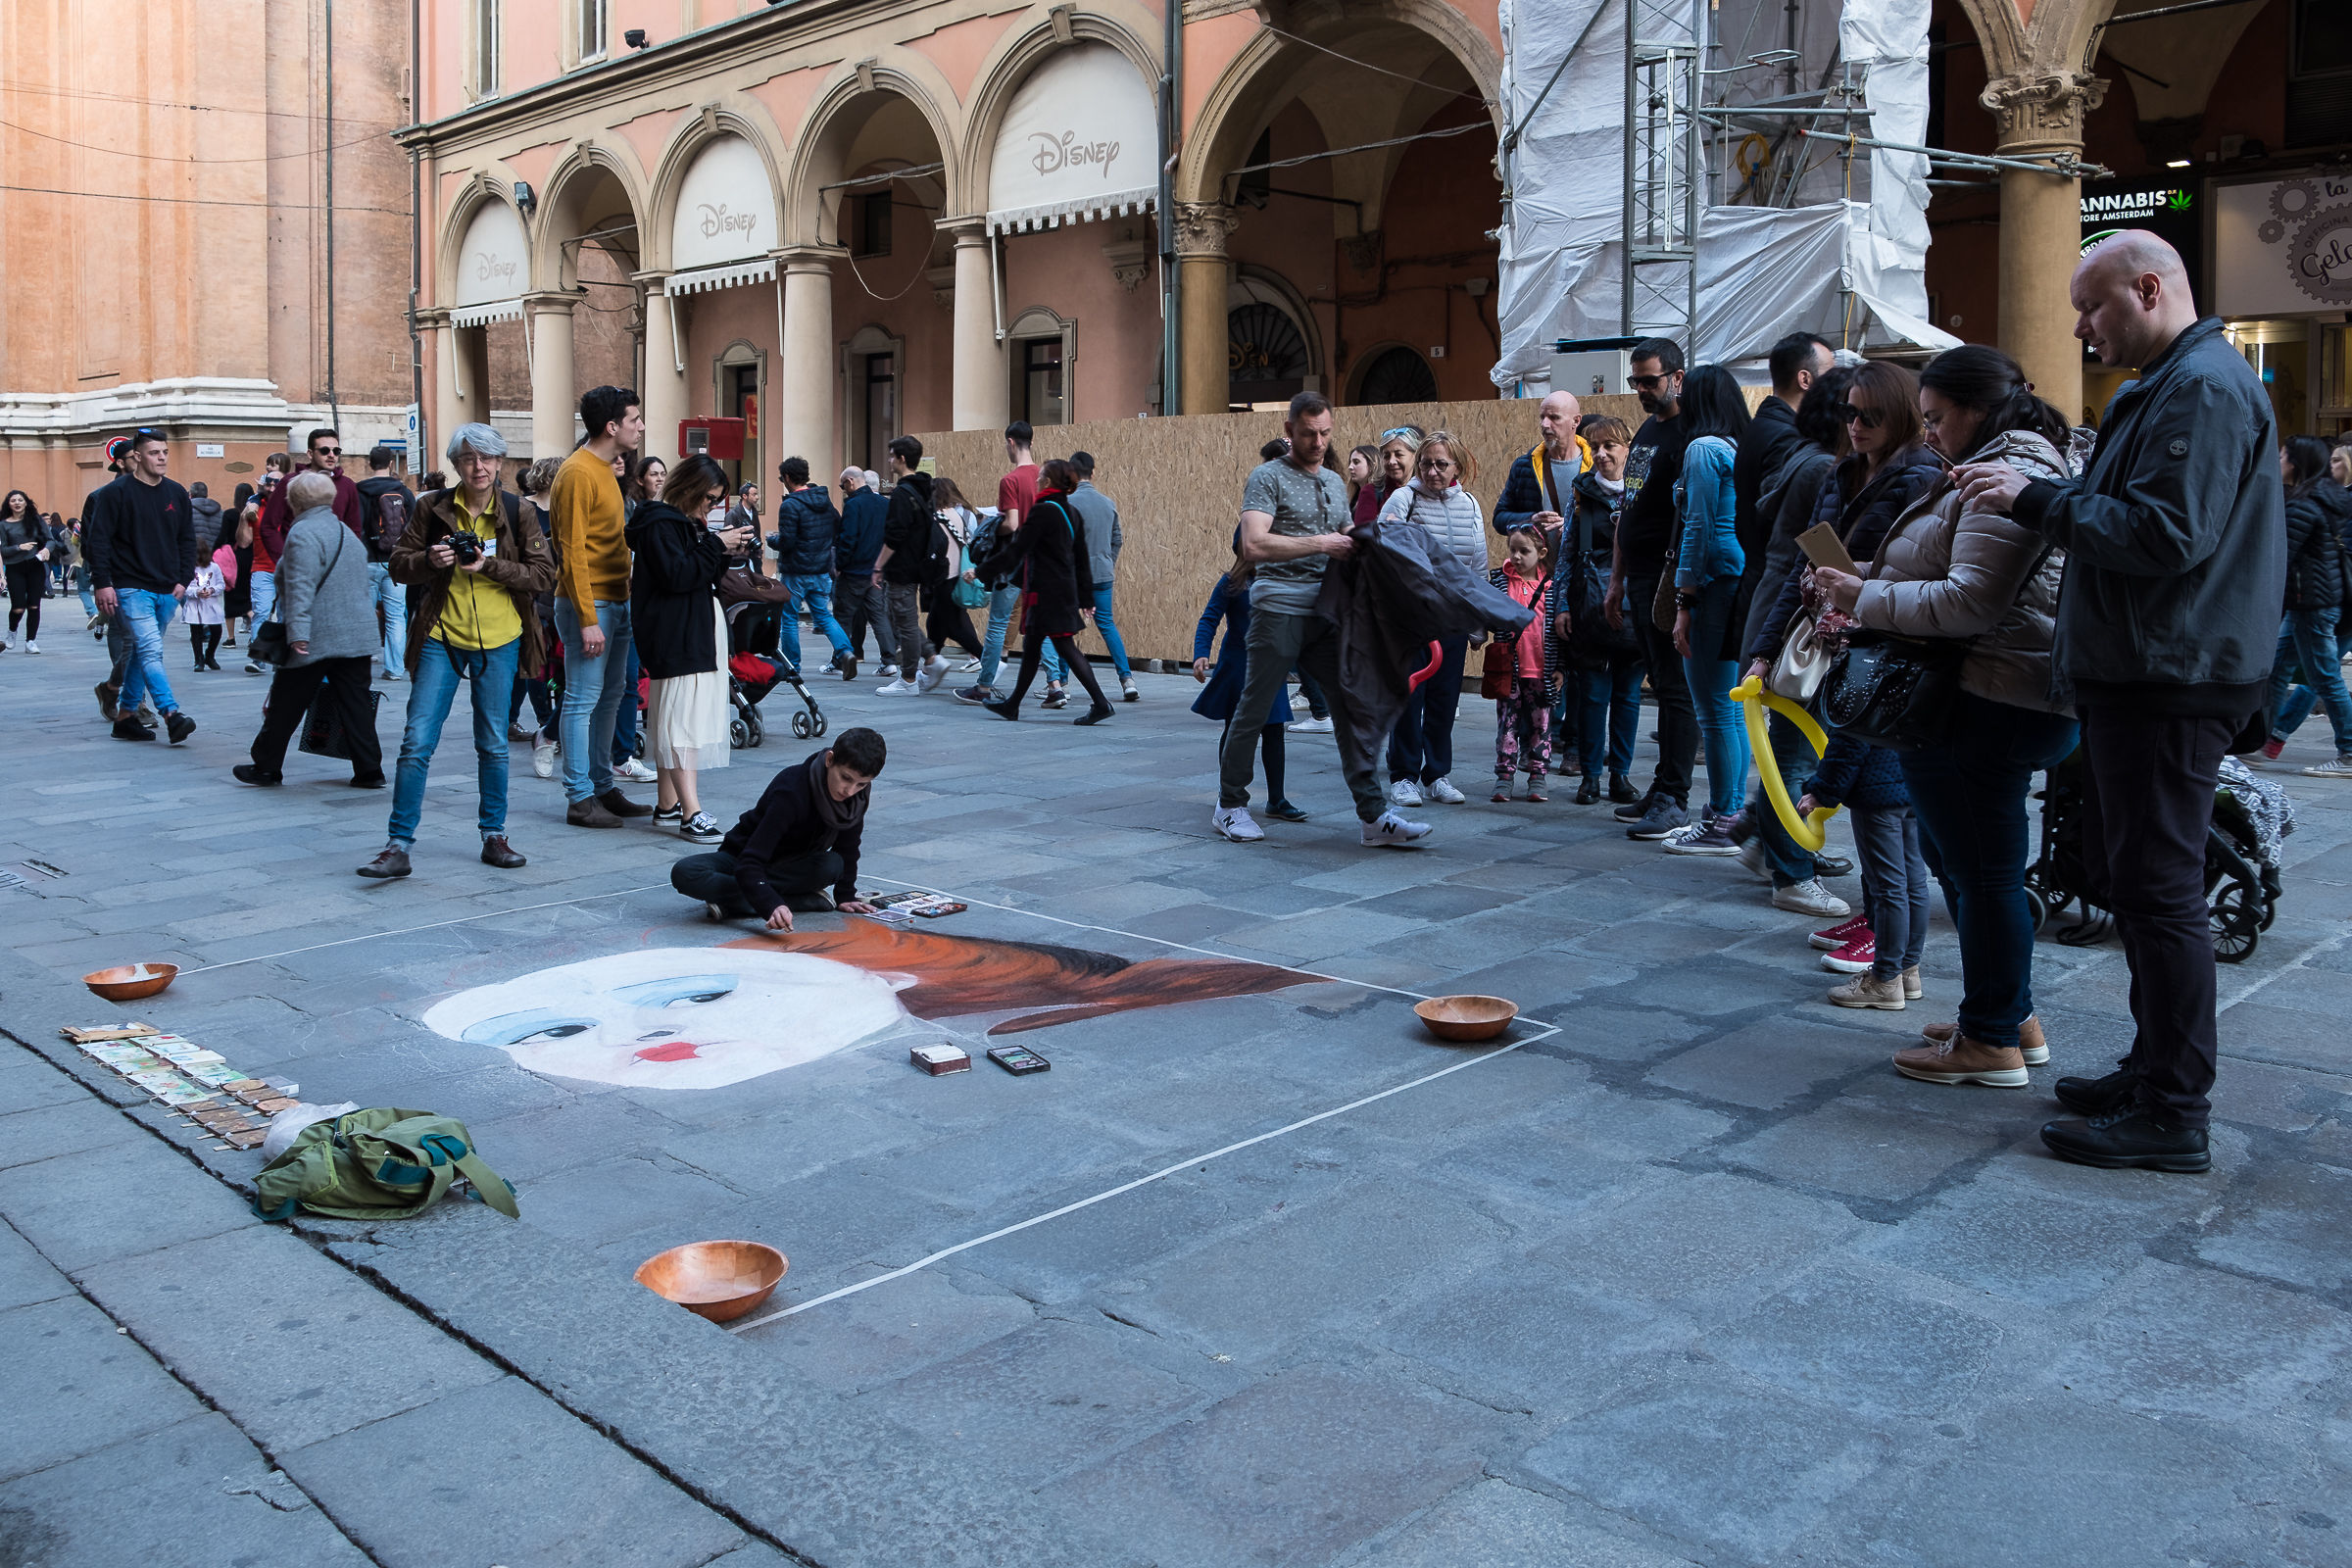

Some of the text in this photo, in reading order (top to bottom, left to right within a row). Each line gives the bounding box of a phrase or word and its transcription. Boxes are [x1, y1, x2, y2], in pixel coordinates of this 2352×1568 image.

[2326, 180, 2349, 198] la
[2080, 190, 2167, 213] ANNABIS
[2080, 209, 2155, 222] TORE AMSTERDAM
[1381, 820, 1397, 834] N
